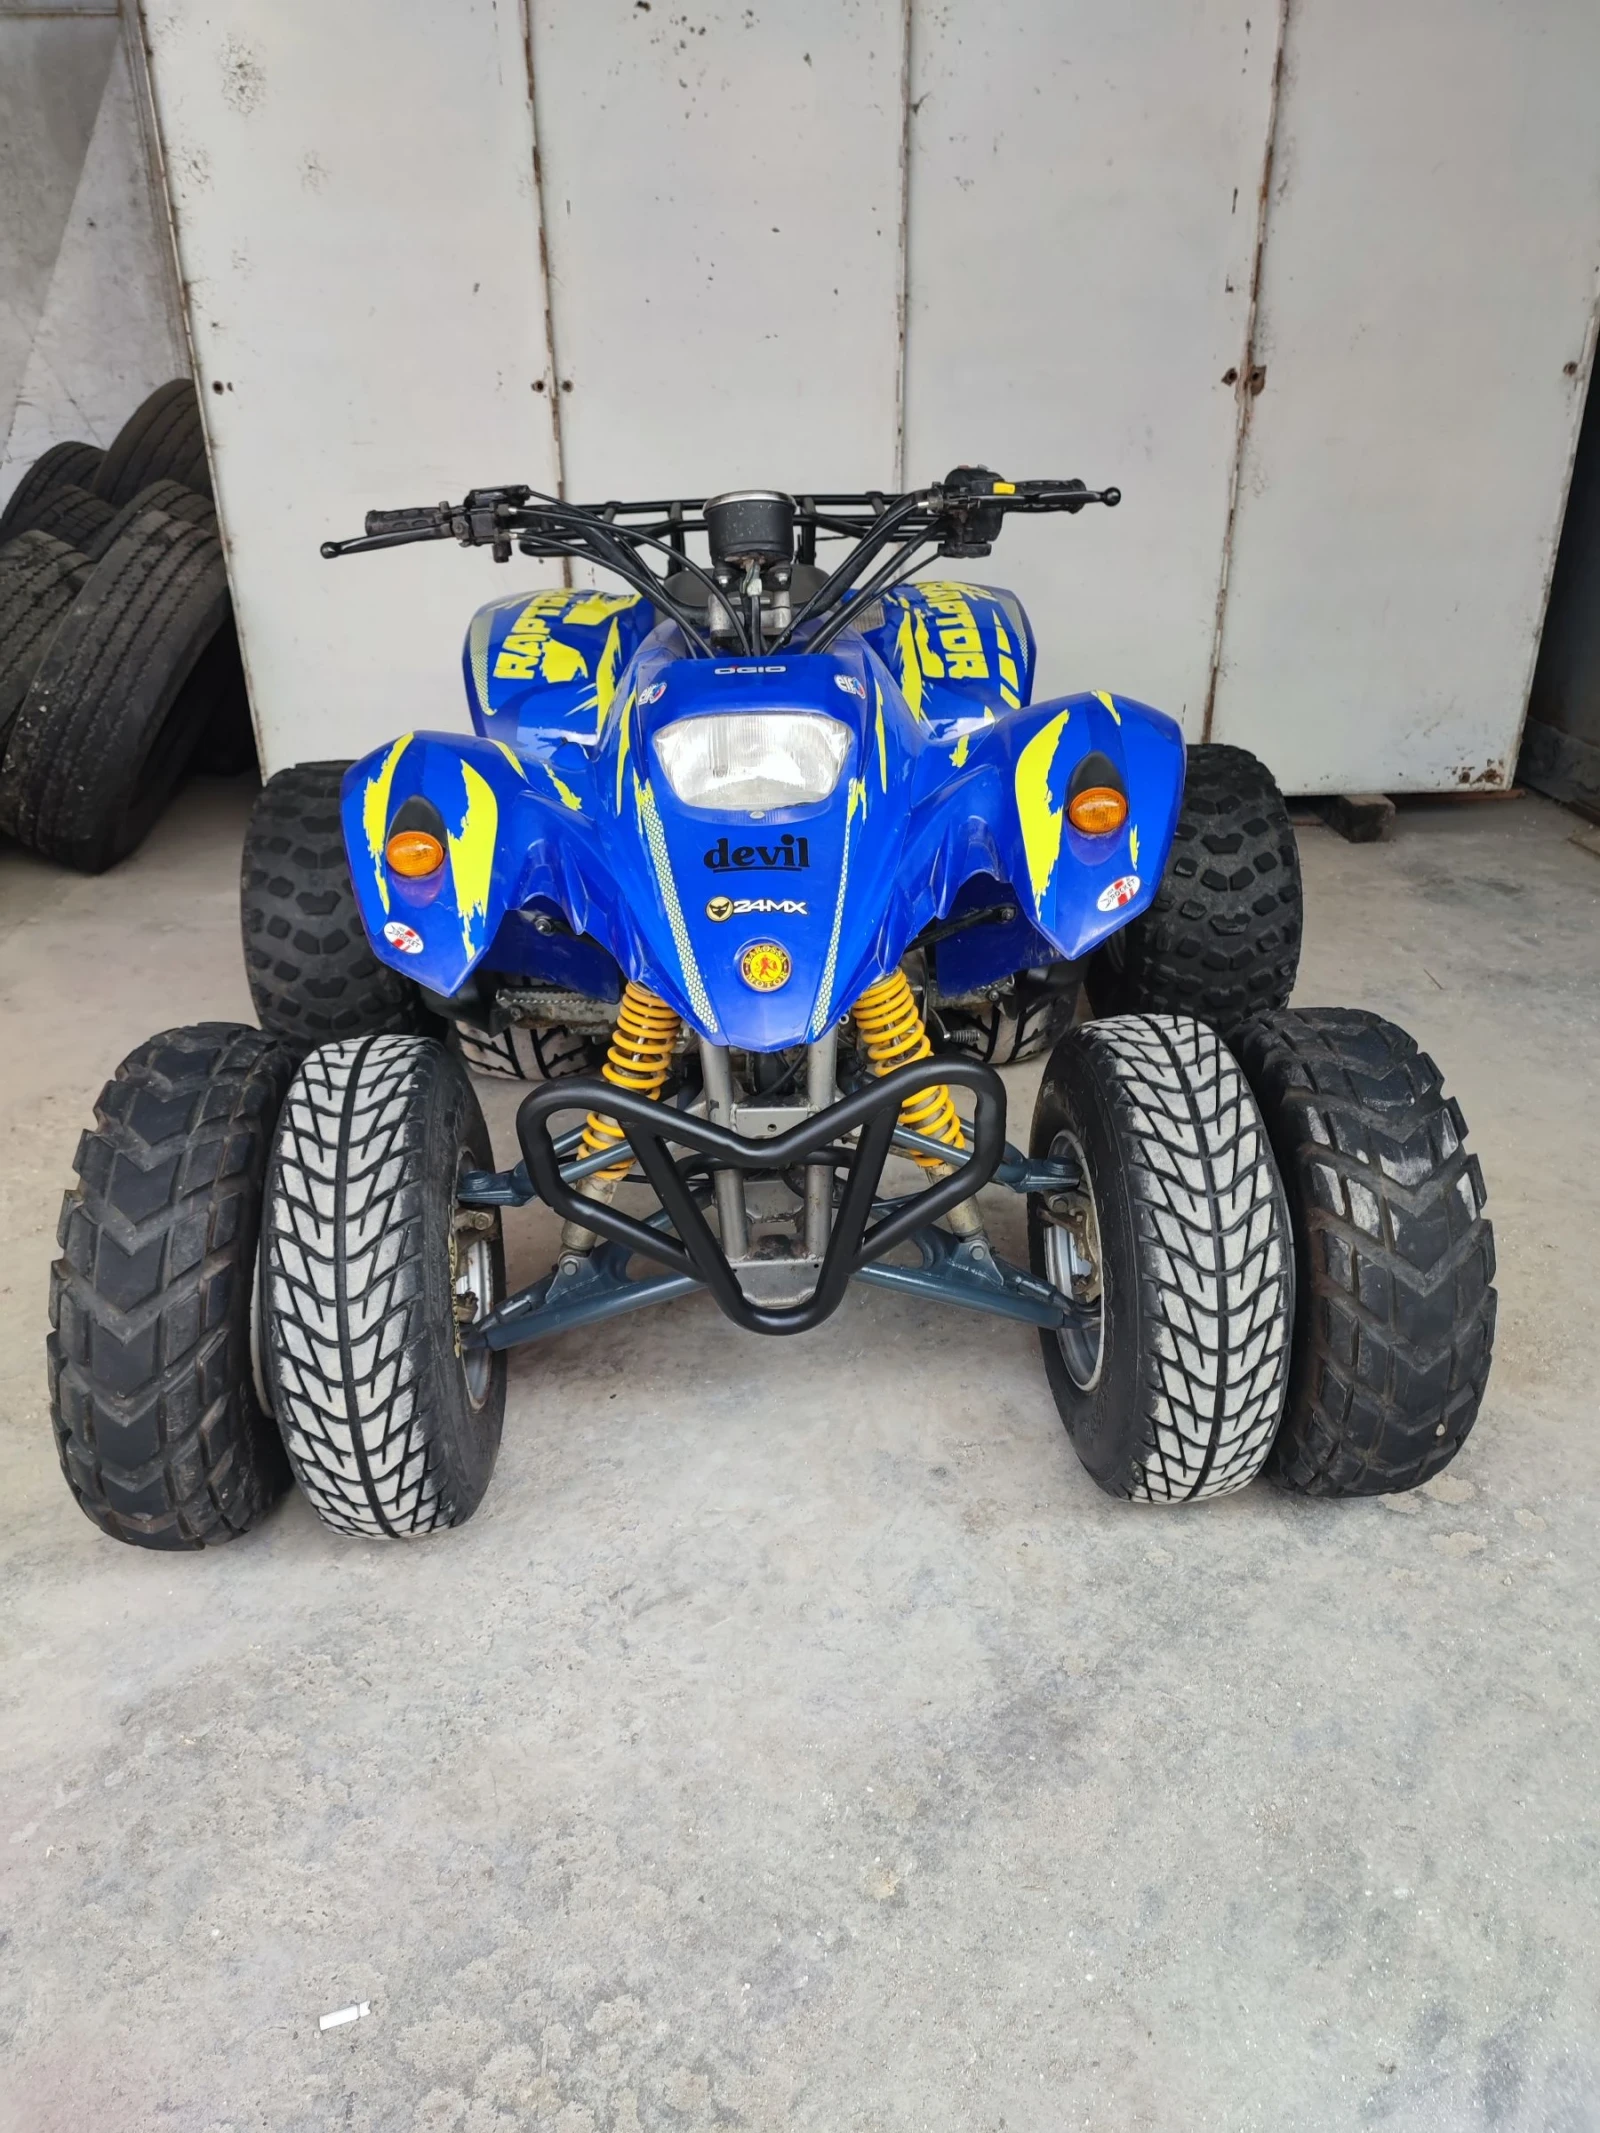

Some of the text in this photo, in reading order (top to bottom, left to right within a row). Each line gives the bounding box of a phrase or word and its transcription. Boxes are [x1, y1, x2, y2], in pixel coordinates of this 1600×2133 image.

[703, 834, 810, 870] devil
[733, 899, 808, 916] 24MX
[744, 945, 787, 964] BAROSSA
[746, 971, 788, 988] MOTOR
